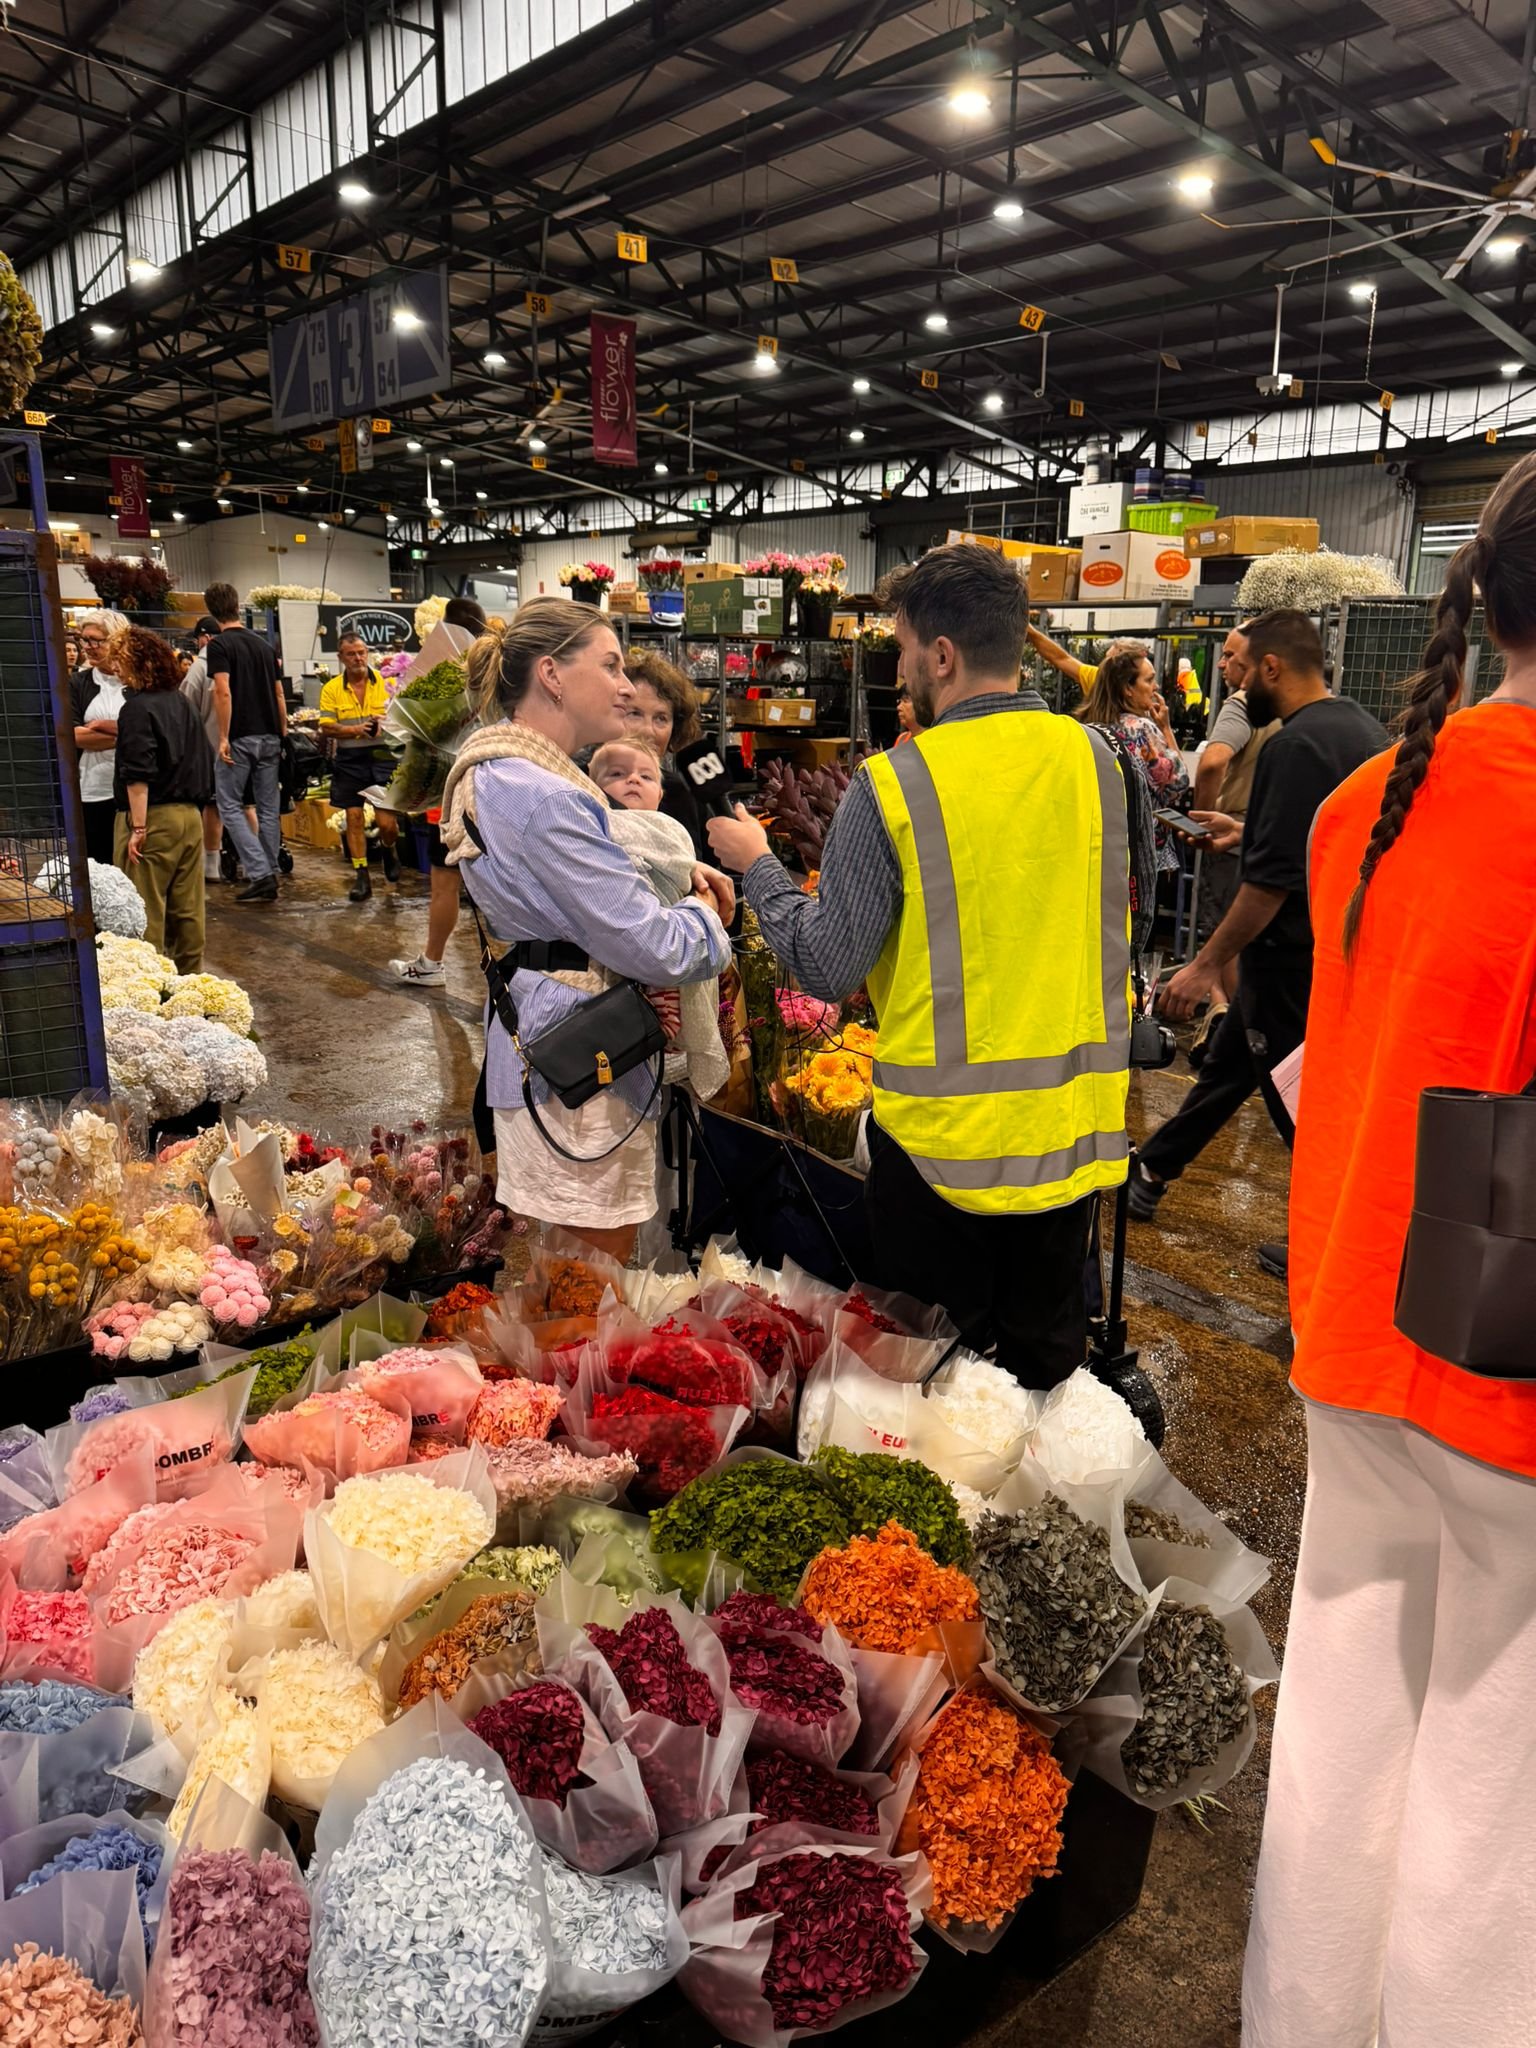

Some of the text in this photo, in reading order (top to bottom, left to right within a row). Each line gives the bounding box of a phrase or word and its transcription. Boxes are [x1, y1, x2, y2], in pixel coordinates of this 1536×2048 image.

[624, 240, 640, 259] 41
[285, 250, 303, 269] 57
[775, 262, 793, 280] 42
[531, 296, 546, 313] 58
[1025, 310, 1039, 328] 43
[309, 319, 326, 356] 73
[338, 307, 364, 407] 3
[377, 359, 397, 398] 64
[600, 334, 619, 423] flower
[27, 412, 45, 424] 66A
[121, 467, 135, 515] flower
[357, 624, 397, 643] AWF
